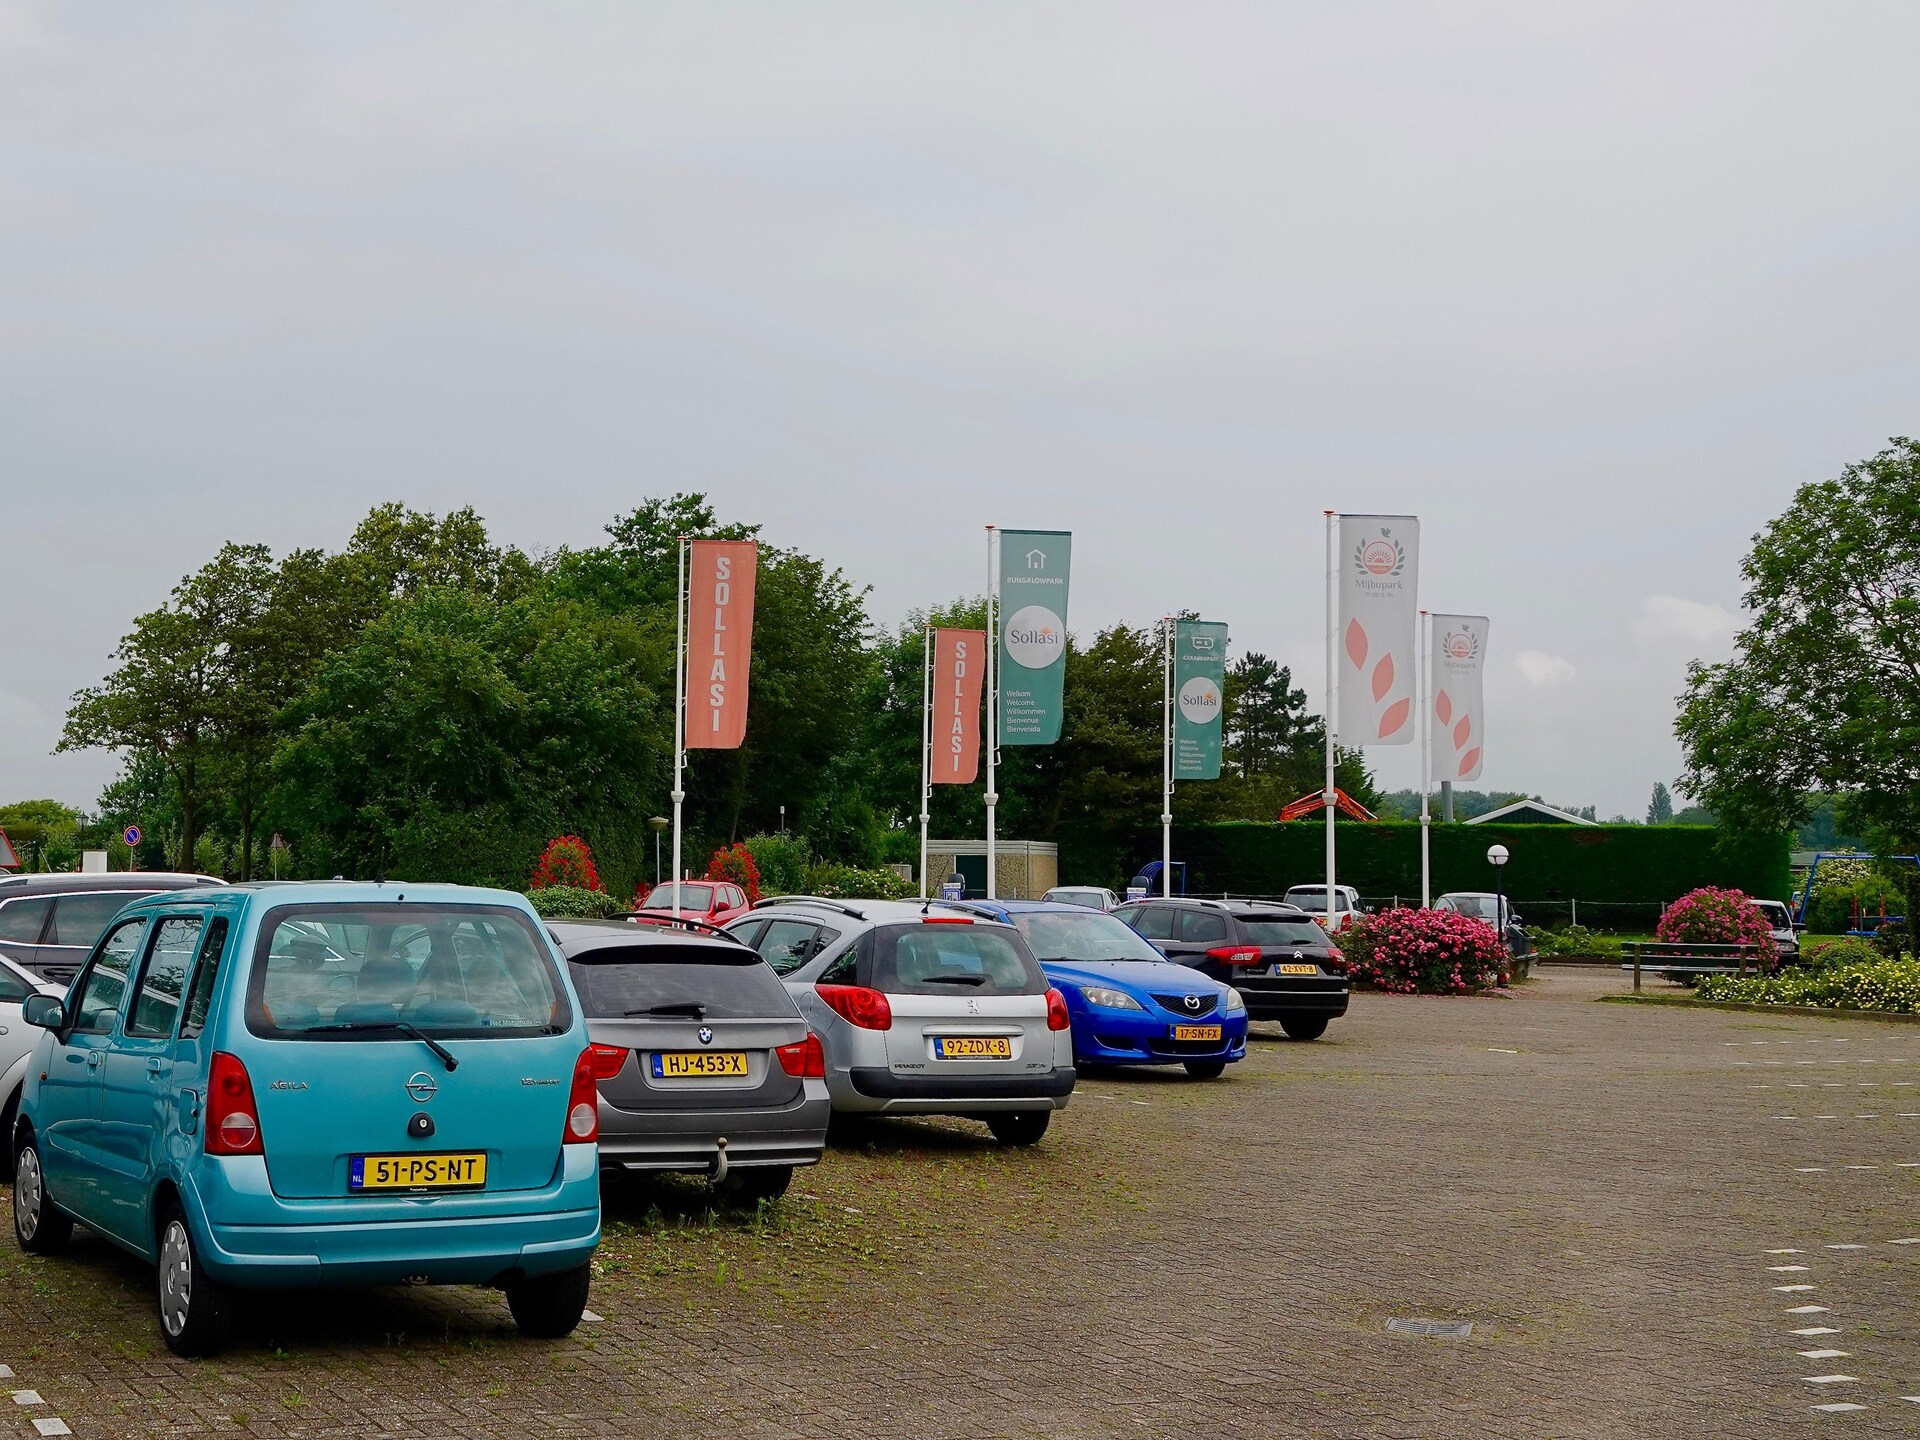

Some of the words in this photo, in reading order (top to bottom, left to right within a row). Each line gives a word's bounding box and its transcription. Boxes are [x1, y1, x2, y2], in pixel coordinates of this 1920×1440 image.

[1006, 576, 1064, 585] BUNGALOWPARK
[1355, 579, 1403, 591] Mijbupark
[1010, 629, 1058, 645] Sollasi
[709, 557, 731, 732] SOLLASI
[951, 641, 967, 772] SOLLASI
[1182, 694, 1217, 707] Sollasi
[1006, 716, 1039, 724] Bienvenue
[1006, 725, 1041, 733] Bienvenida
[1282, 964, 1314, 973] 42-XVT-8
[1180, 1029, 1218, 1039] 17-SN-FX
[946, 1040, 1006, 1054] 92-ZDK-8
[669, 1055, 742, 1073] HJ-453-X
[269, 1080, 308, 1090] AGILA
[376, 1158, 477, 1183] 51-PS-NT
[352, 1174, 363, 1183] NL
